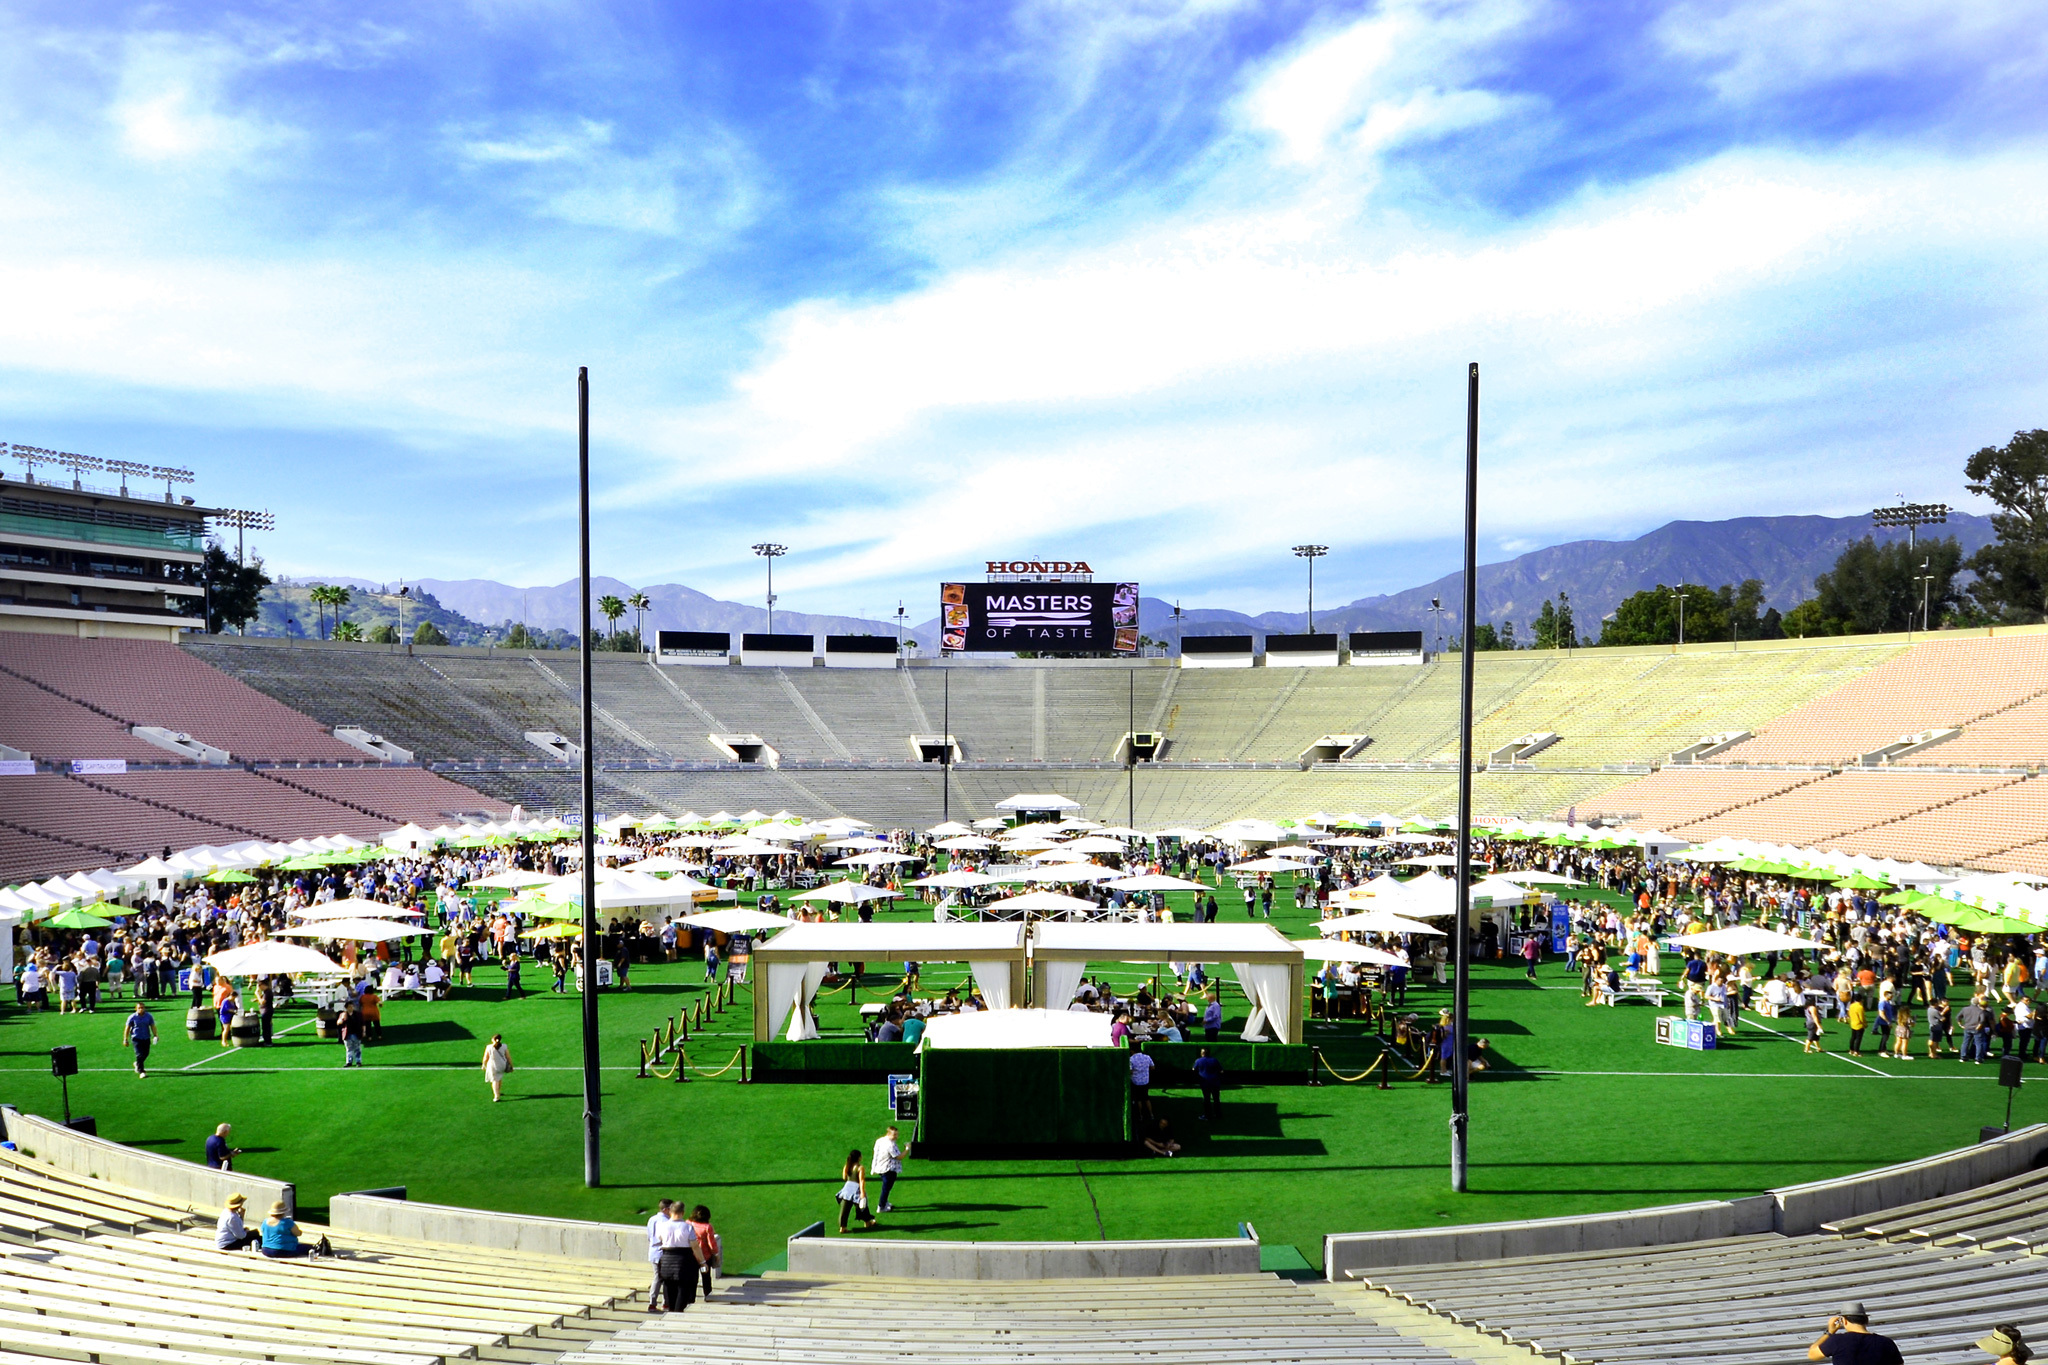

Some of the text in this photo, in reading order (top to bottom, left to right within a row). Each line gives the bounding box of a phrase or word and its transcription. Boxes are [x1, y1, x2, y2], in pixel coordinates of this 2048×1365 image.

[986, 561, 1094, 574] HONDA
[986, 595, 1093, 611] MASTERS
[986, 628, 1093, 638] OF TASTE
